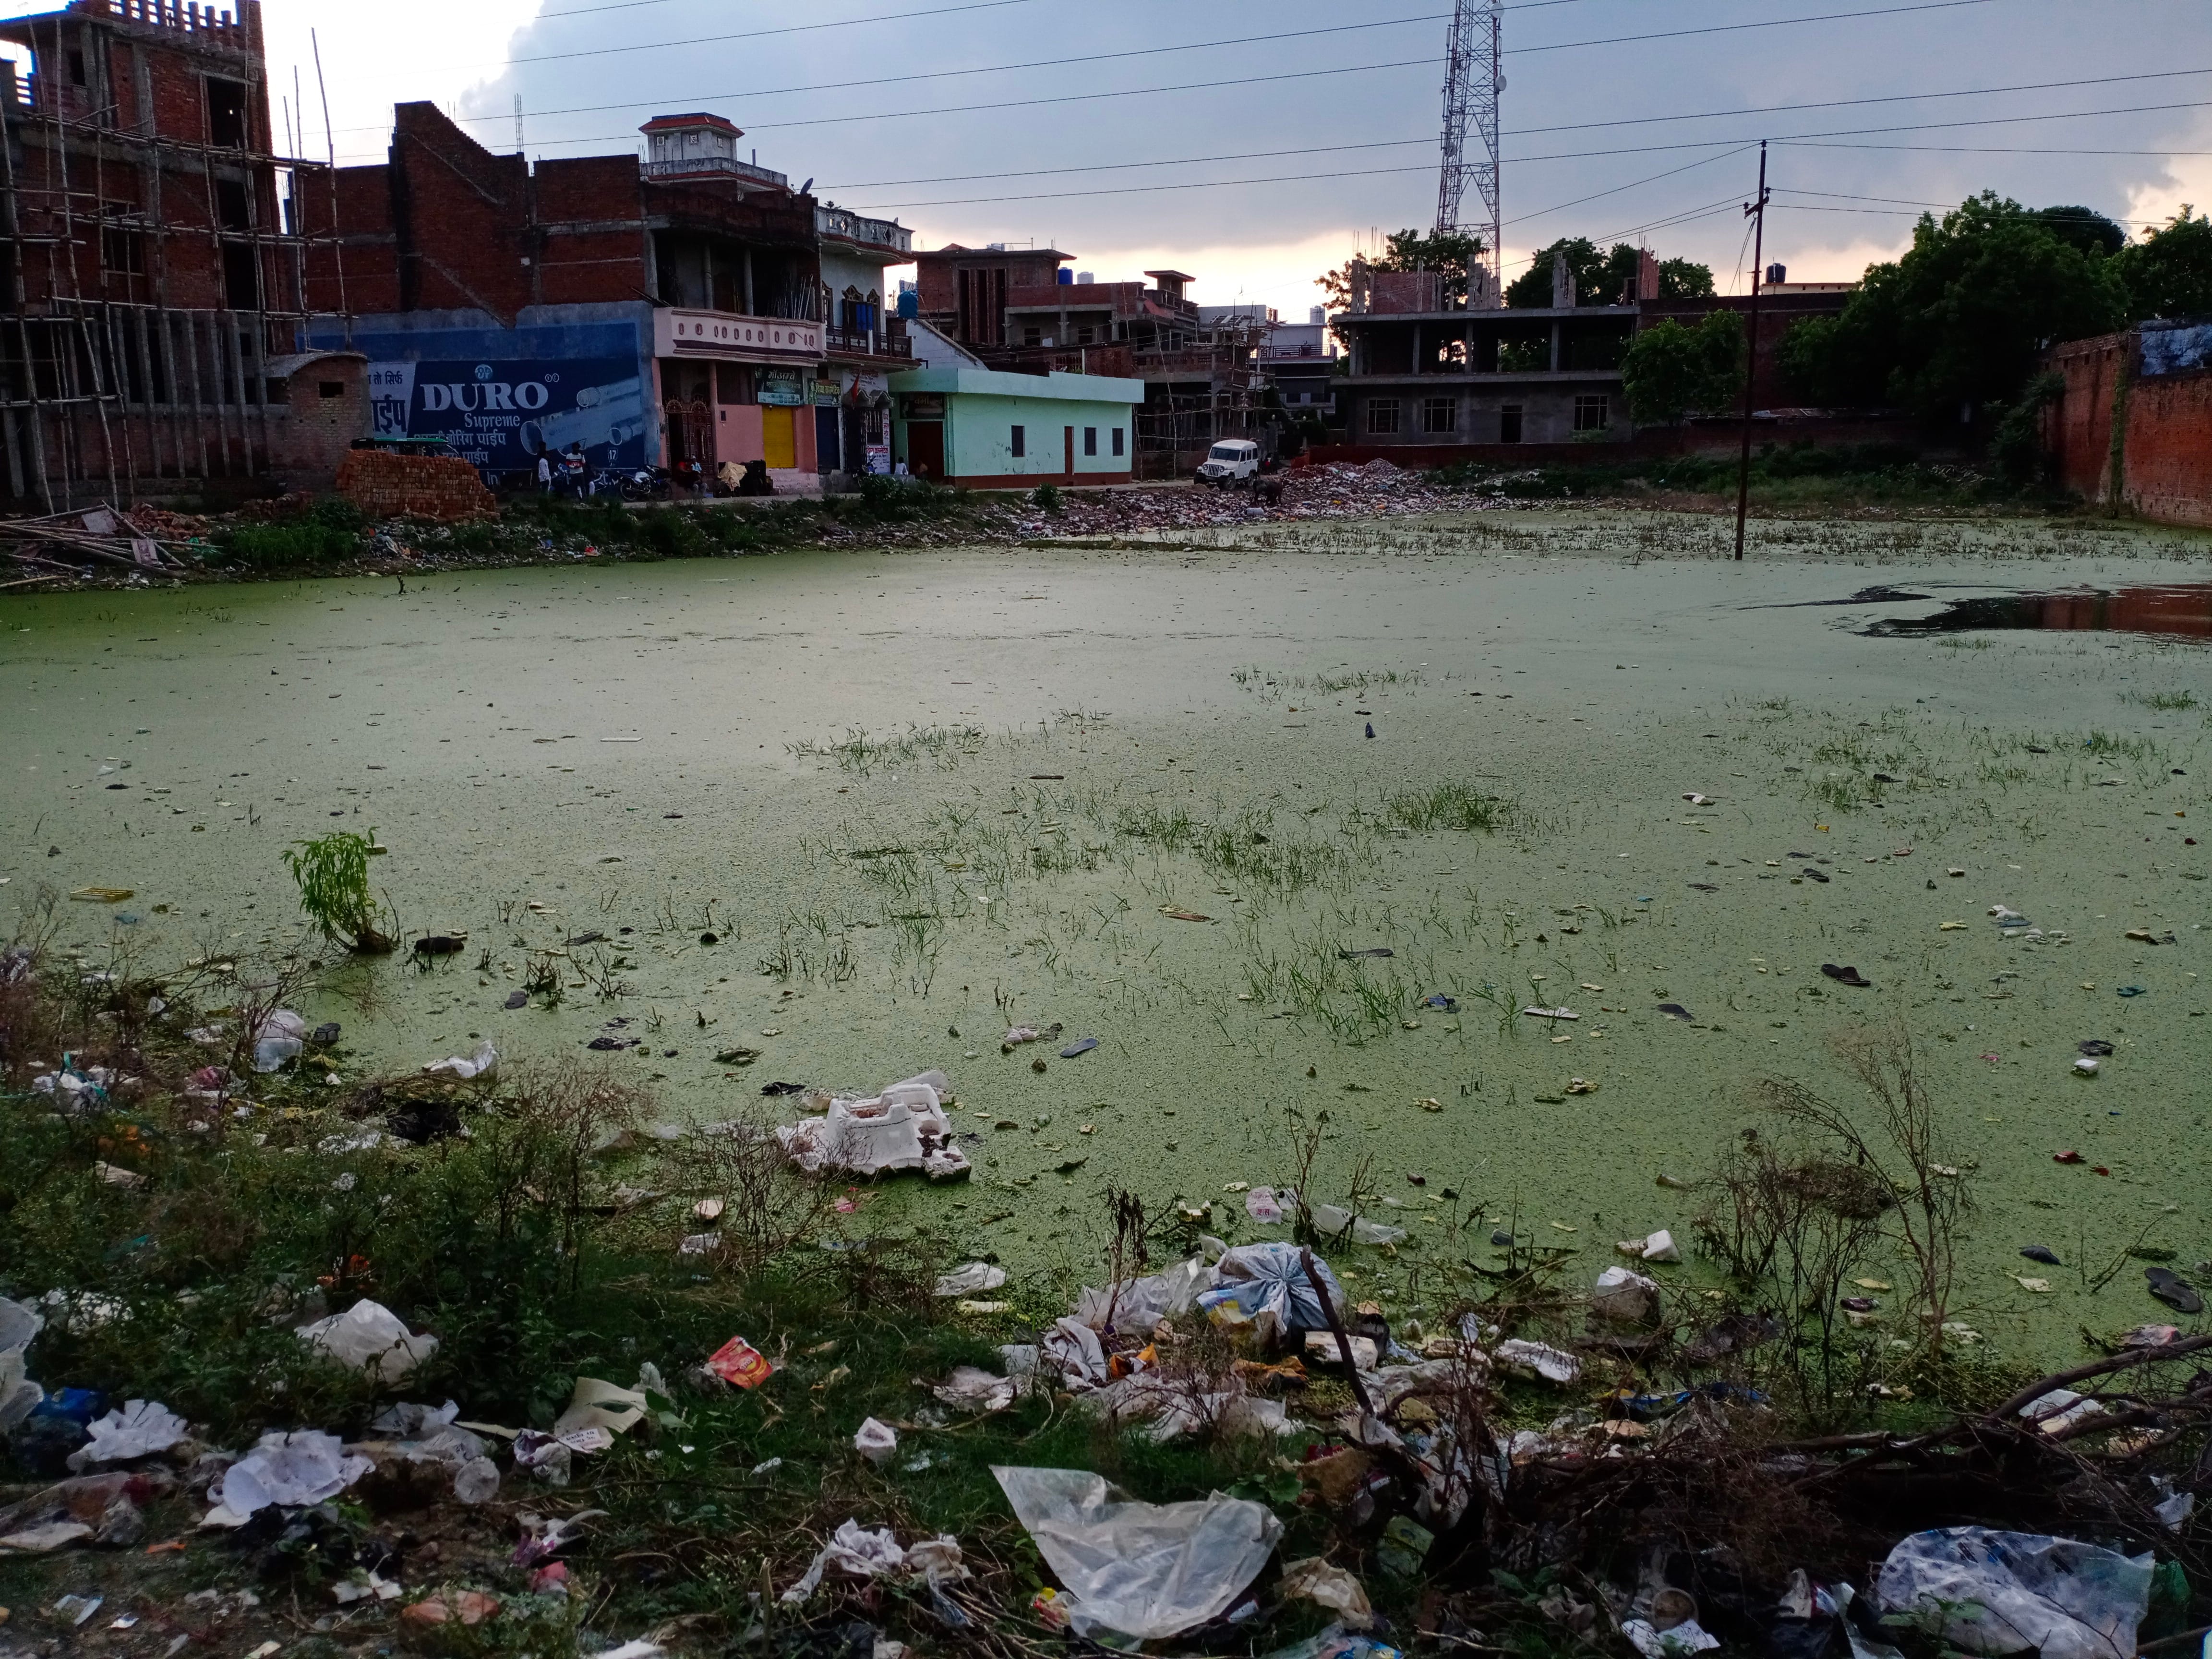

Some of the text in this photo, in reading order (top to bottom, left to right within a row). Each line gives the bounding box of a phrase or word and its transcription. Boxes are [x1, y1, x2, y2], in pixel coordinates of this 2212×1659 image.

[373, 372, 382, 385] तो
[385, 371, 403, 385] सिर्फ
[420, 382, 549, 411] DURO
[371, 394, 407, 434] ाईप
[464, 412, 520, 432] Supreme
[476, 429, 506, 447] पाईप
[461, 447, 489, 465] पाईप
[609, 449, 616, 459] 17
